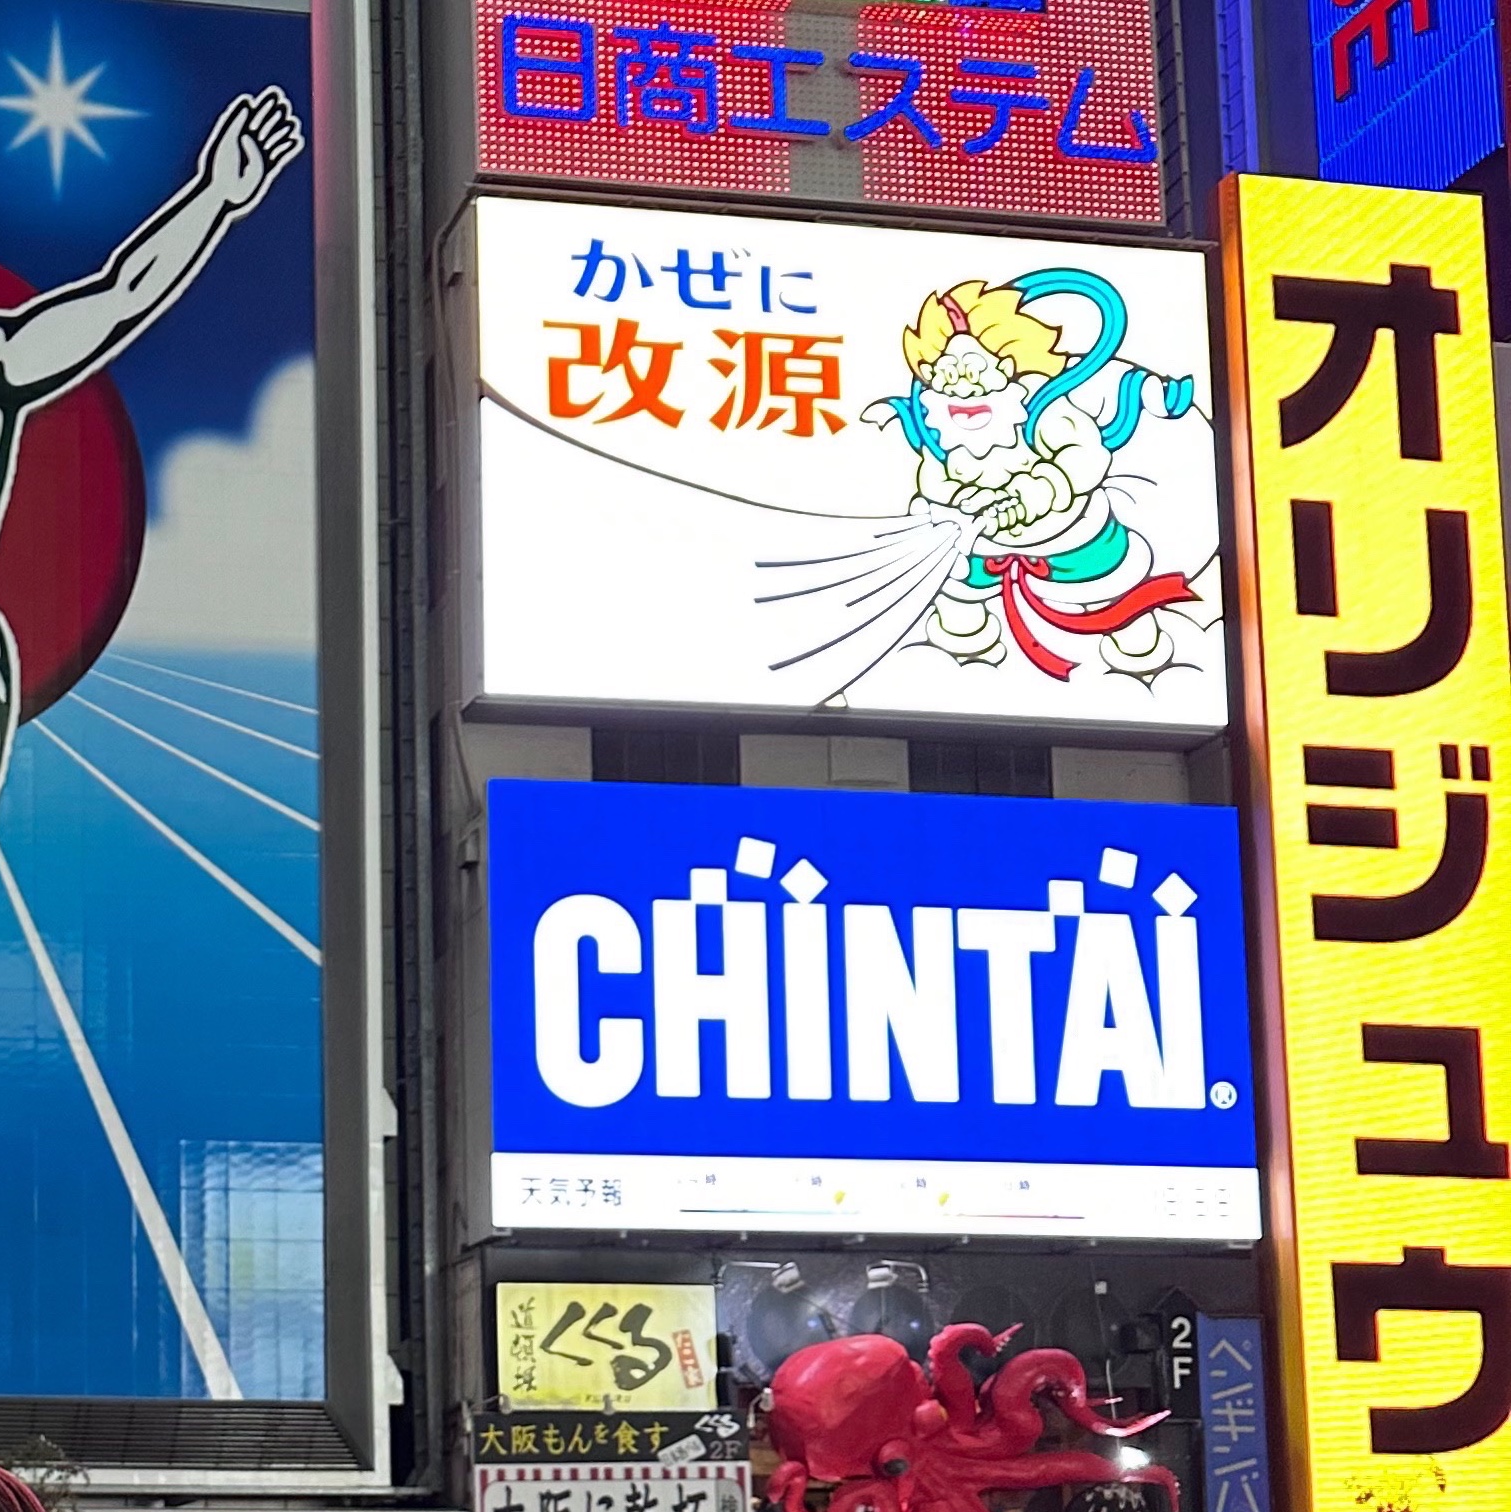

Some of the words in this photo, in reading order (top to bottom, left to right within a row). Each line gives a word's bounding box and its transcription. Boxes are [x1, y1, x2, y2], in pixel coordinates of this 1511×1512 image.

[500, 13, 1159, 165] 日商エステム
[571, 238, 818, 314] かぜに
[542, 318, 848, 437] 改源
[1272, 263, 1511, 1455] オリジュウ
[533, 836, 1206, 1110] CHINTAI
[520, 1176, 623, 1207] 天気予報
[539, 1301, 673, 1391] くくる
[1170, 1315, 1194, 1390] 2F
[479, 1420, 670, 1456] 大阪もんを食す
[710, 1439, 742, 1461] 2F
